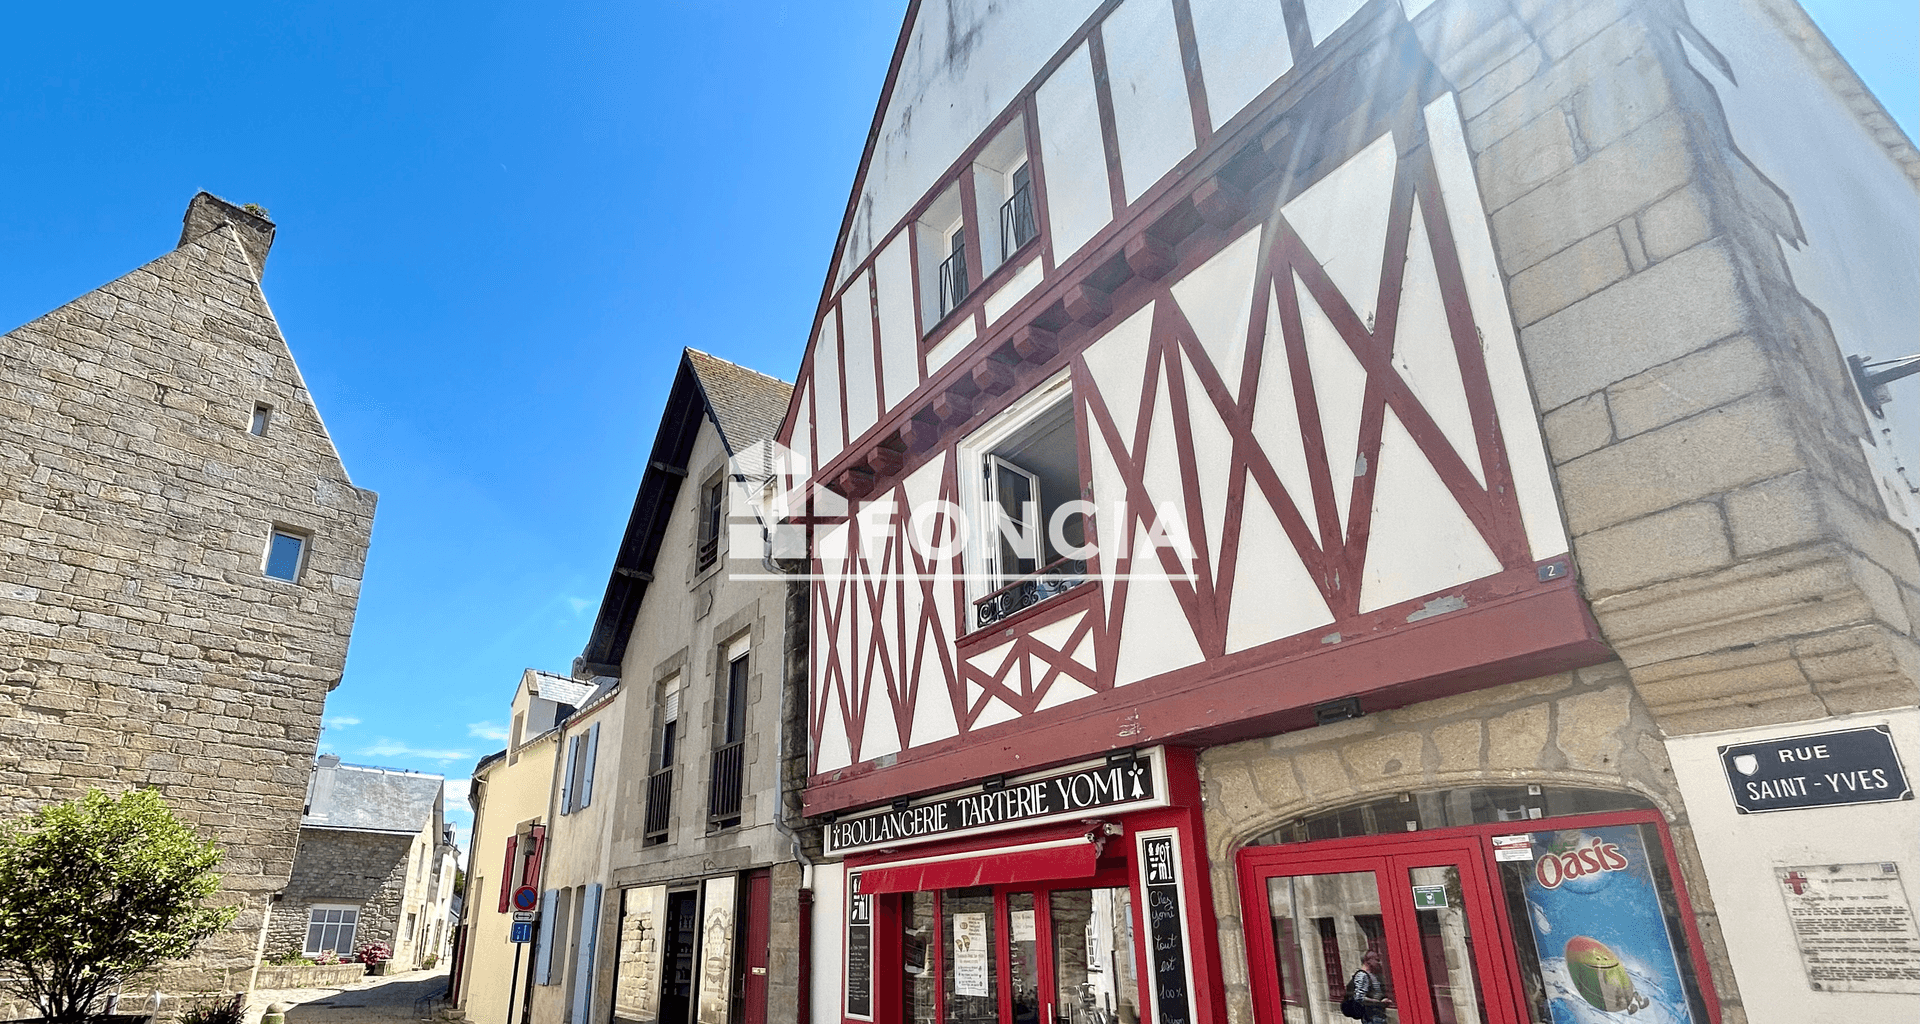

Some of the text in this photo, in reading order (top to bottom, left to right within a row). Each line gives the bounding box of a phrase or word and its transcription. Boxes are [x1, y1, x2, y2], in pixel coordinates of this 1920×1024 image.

[1547, 565, 1556, 577] 2
[1778, 744, 1831, 763] RUE
[841, 767, 1125, 848] BOULANGERIE TARTERIE YOMI
[1535, 836, 1629, 889] Oasis
[1154, 933, 1177, 951] tout
[1160, 956, 1176, 973] est
